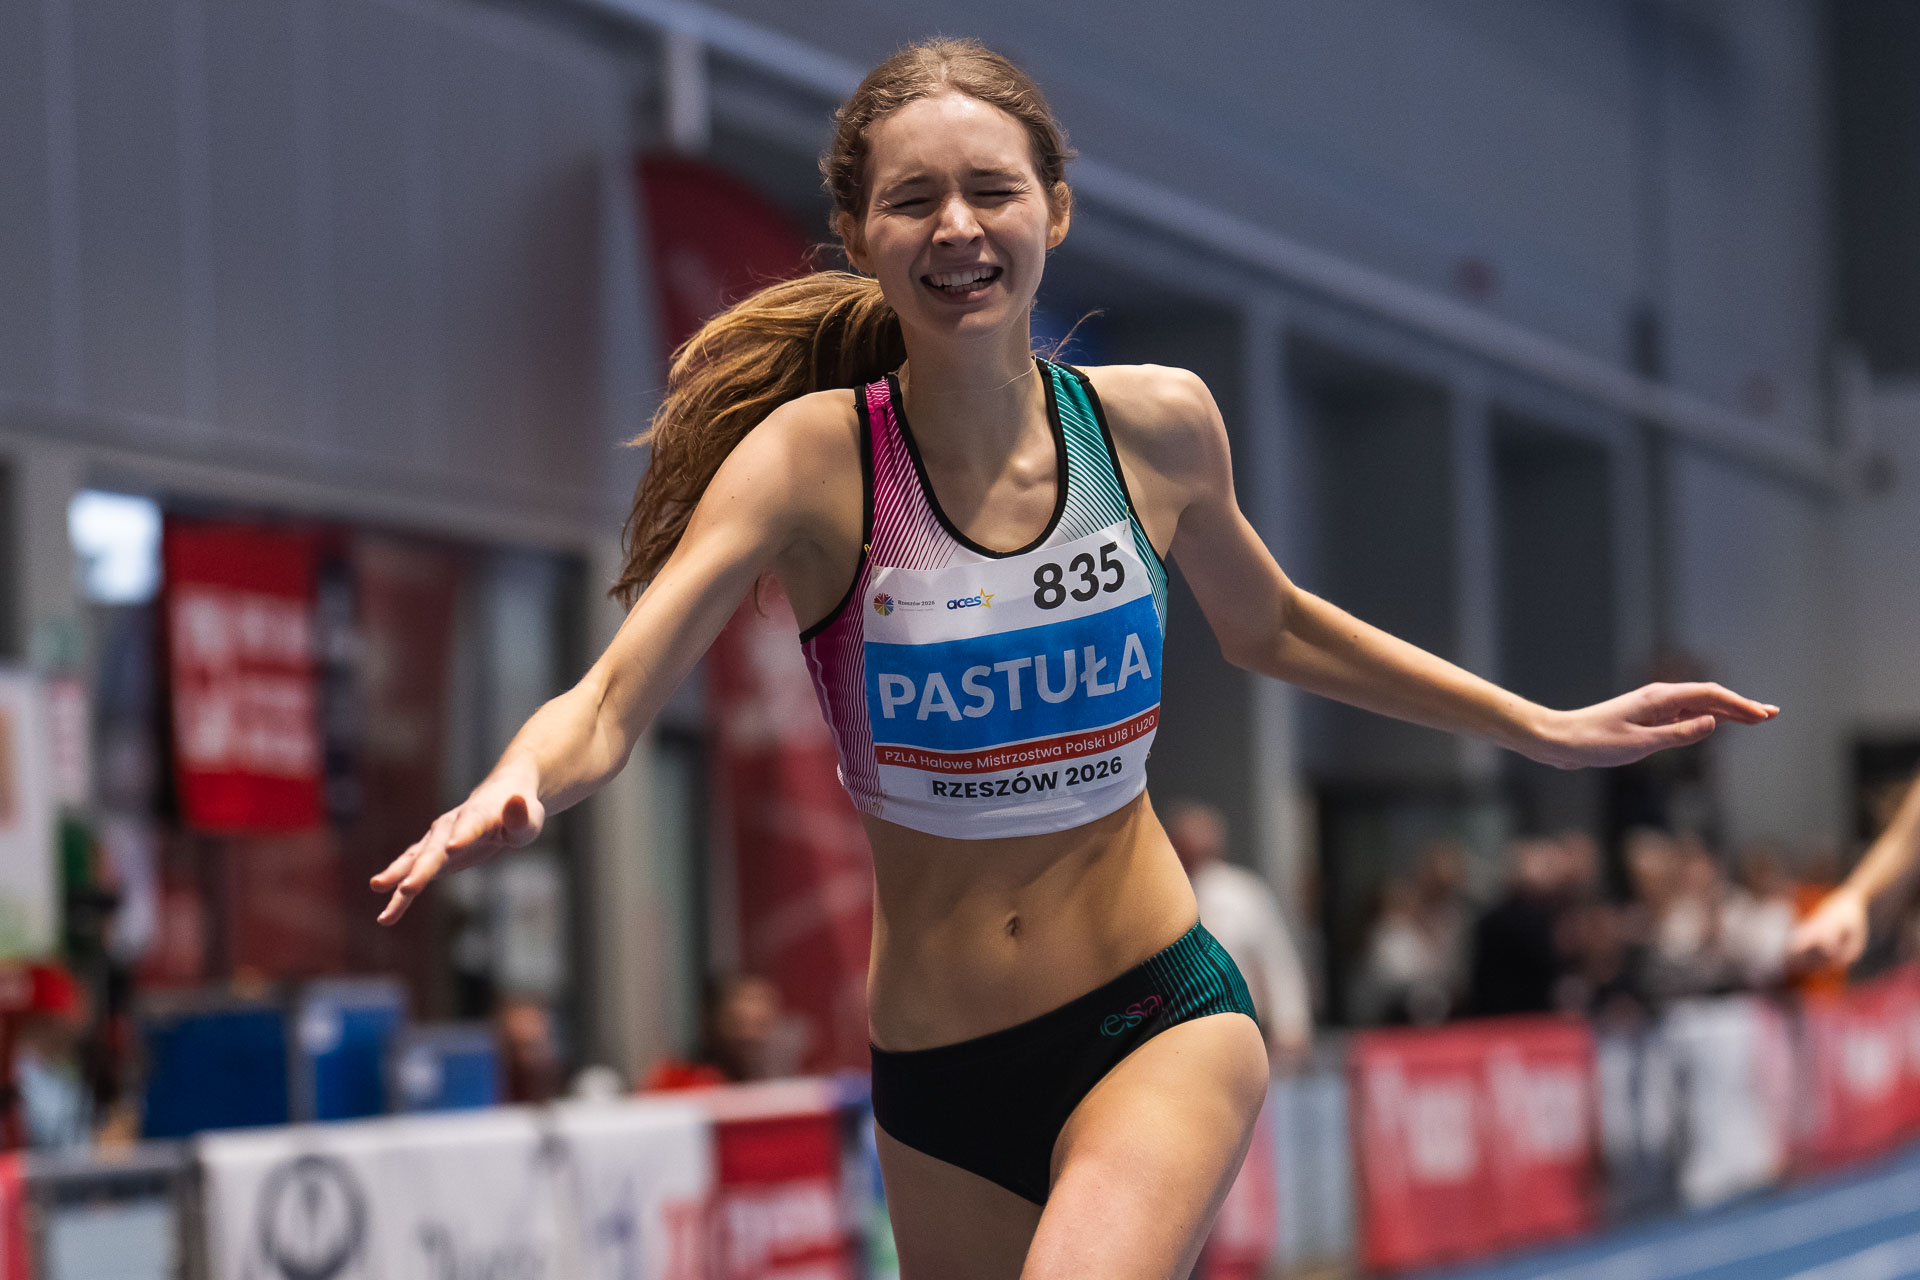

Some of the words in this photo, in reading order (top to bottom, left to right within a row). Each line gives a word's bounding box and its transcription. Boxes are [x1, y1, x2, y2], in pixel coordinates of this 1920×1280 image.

[946, 595, 982, 610] aces
[1033, 541, 1125, 610] 835
[878, 633, 1152, 721] PASTUŁA
[885, 751, 917, 764] PZLA
[920, 756, 973, 769] Halowe
[977, 745, 1062, 768] Mistrzostwa
[1065, 735, 1106, 754] Polski
[1108, 728, 1129, 744] U18
[1130, 725, 1134, 736] i
[1136, 715, 1155, 732] U20
[932, 771, 1058, 798] RZESZÓW
[1065, 756, 1122, 787] 2026
